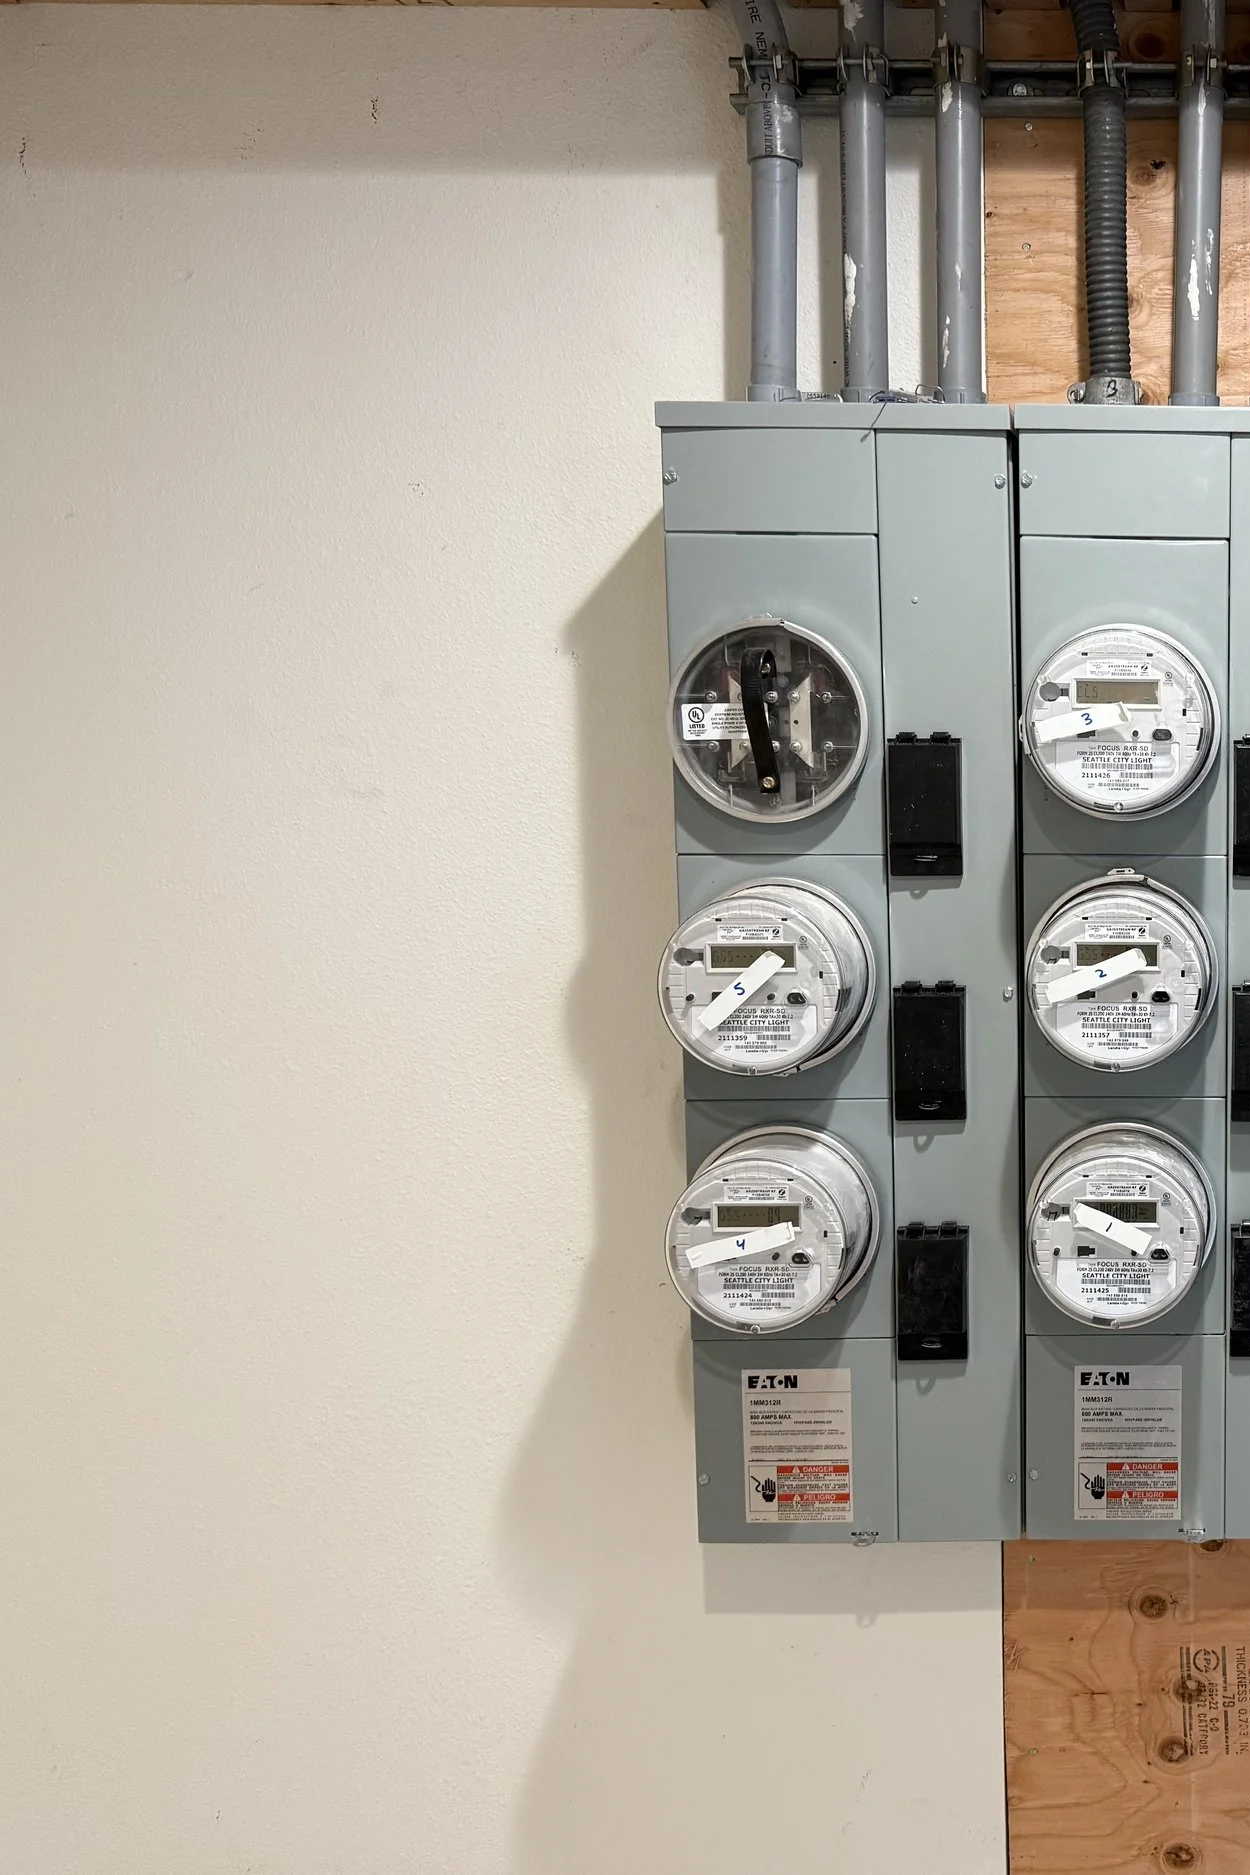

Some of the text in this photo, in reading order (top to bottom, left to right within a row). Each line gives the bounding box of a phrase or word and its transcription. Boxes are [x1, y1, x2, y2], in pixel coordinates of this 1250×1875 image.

[745, 0, 762, 24] IRE
[755, 31, 768, 60] NEM
[764, 133, 774, 155] DUIT
[1081, 712, 1093, 726] 3
[1094, 969, 1107, 978] 2
[733, 982, 745, 996] 5
[1105, 1222, 1112, 1232] 1
[736, 1239, 746, 1250] 4
[748, 1375, 798, 1388] EATON
[1080, 1372, 1129, 1385] EATON
[1236, 1646, 1247, 1702] THICKNESS
[1222, 1694, 1235, 1708] 79
